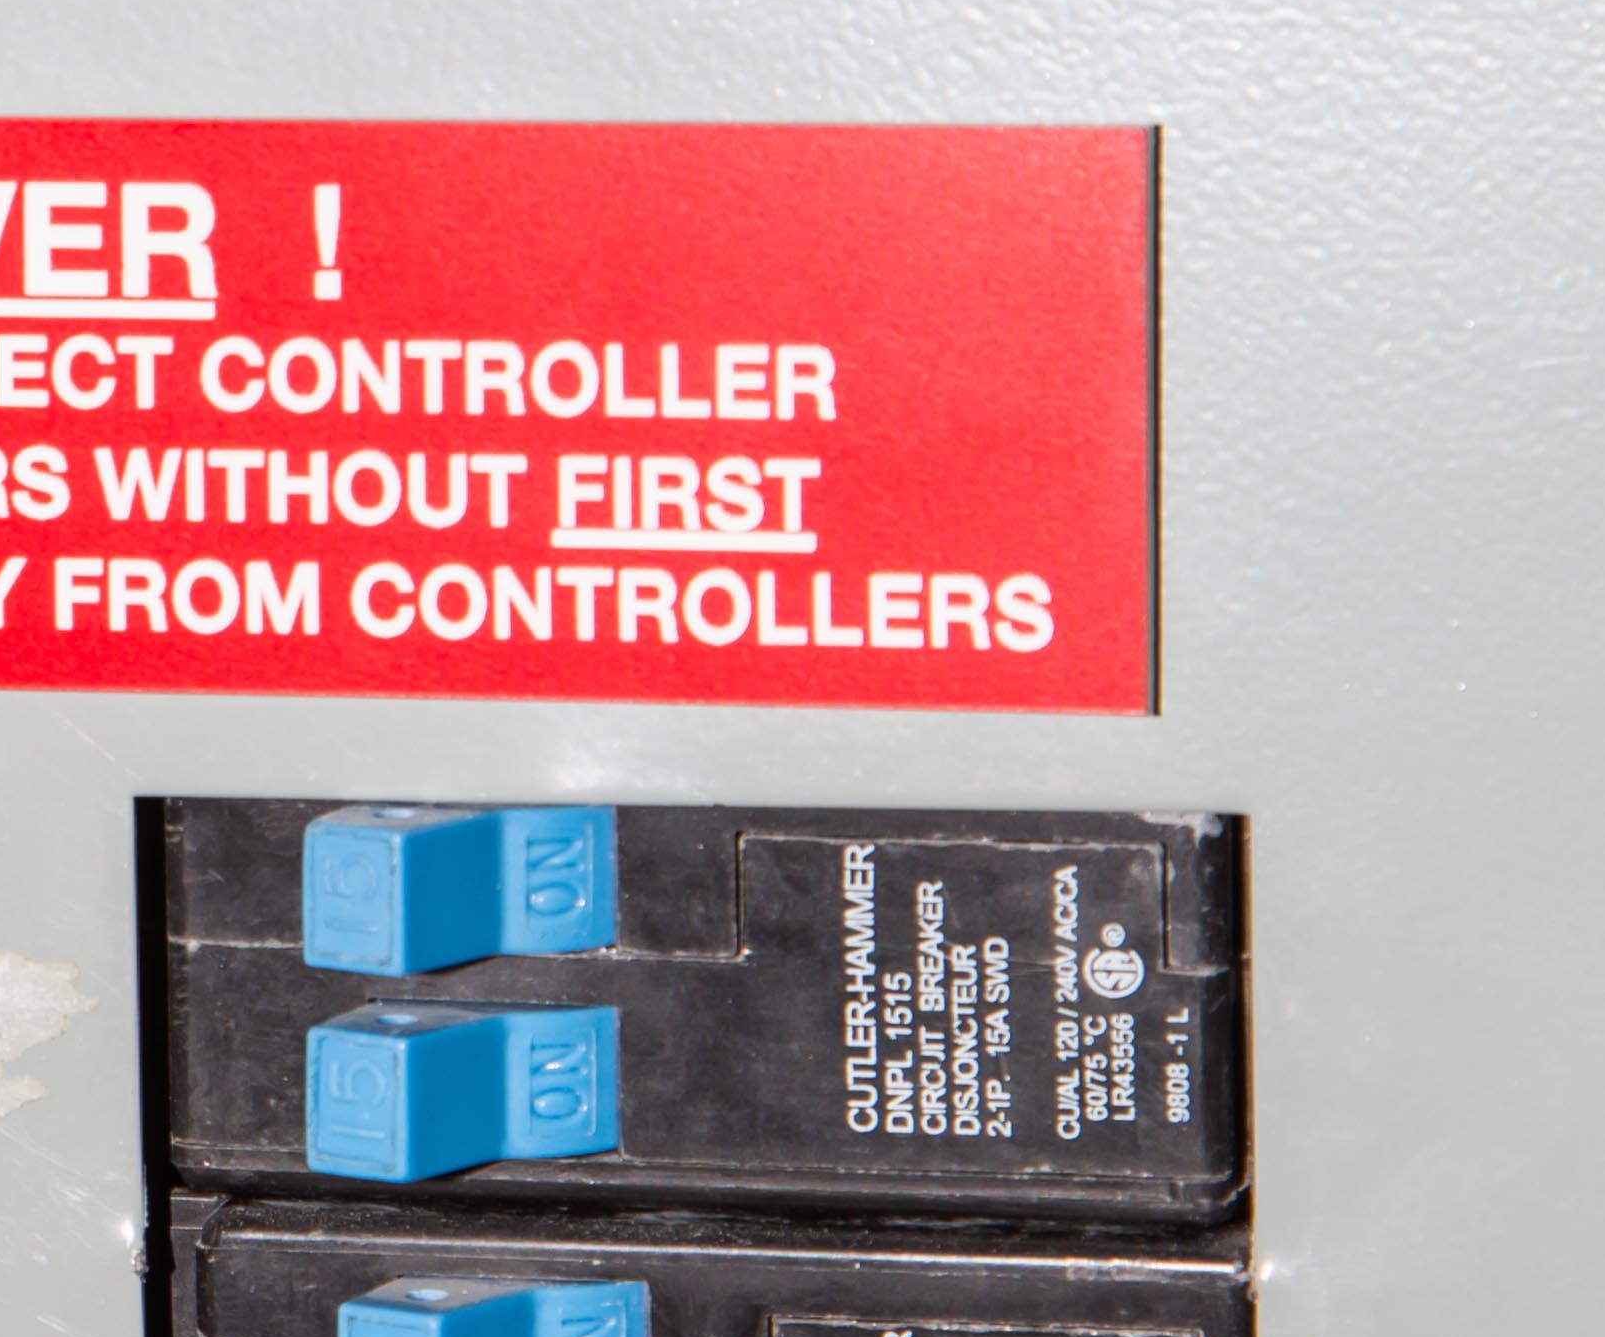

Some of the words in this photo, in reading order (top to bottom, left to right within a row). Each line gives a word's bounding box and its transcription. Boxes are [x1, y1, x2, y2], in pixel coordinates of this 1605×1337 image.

[313, 183, 342, 301] !
[199, 335, 837, 421] CONTROLLER
[93, 447, 528, 529] WITHOUT
[557, 455, 822, 534] FIRST
[54, 557, 320, 636] FROM
[350, 561, 1054, 653] CONTROLLERS
[527, 836, 585, 917] ON
[842, 843, 879, 1133] CUTLER-HAMMER
[917, 881, 945, 1012] BREAKER
[983, 937, 1010, 1003] SWD
[883, 972, 913, 1040] 1515
[948, 945, 982, 1136] DISJONCTEUR
[985, 1008, 1011, 1056] 15A
[531, 1044, 588, 1120] ON
[884, 1050, 914, 1134] DNPL
[919, 1025, 947, 1135] CIRCUIT
[1084, 1053, 1108, 1121] 60/75
[1110, 1013, 1136, 1121] LR43556
